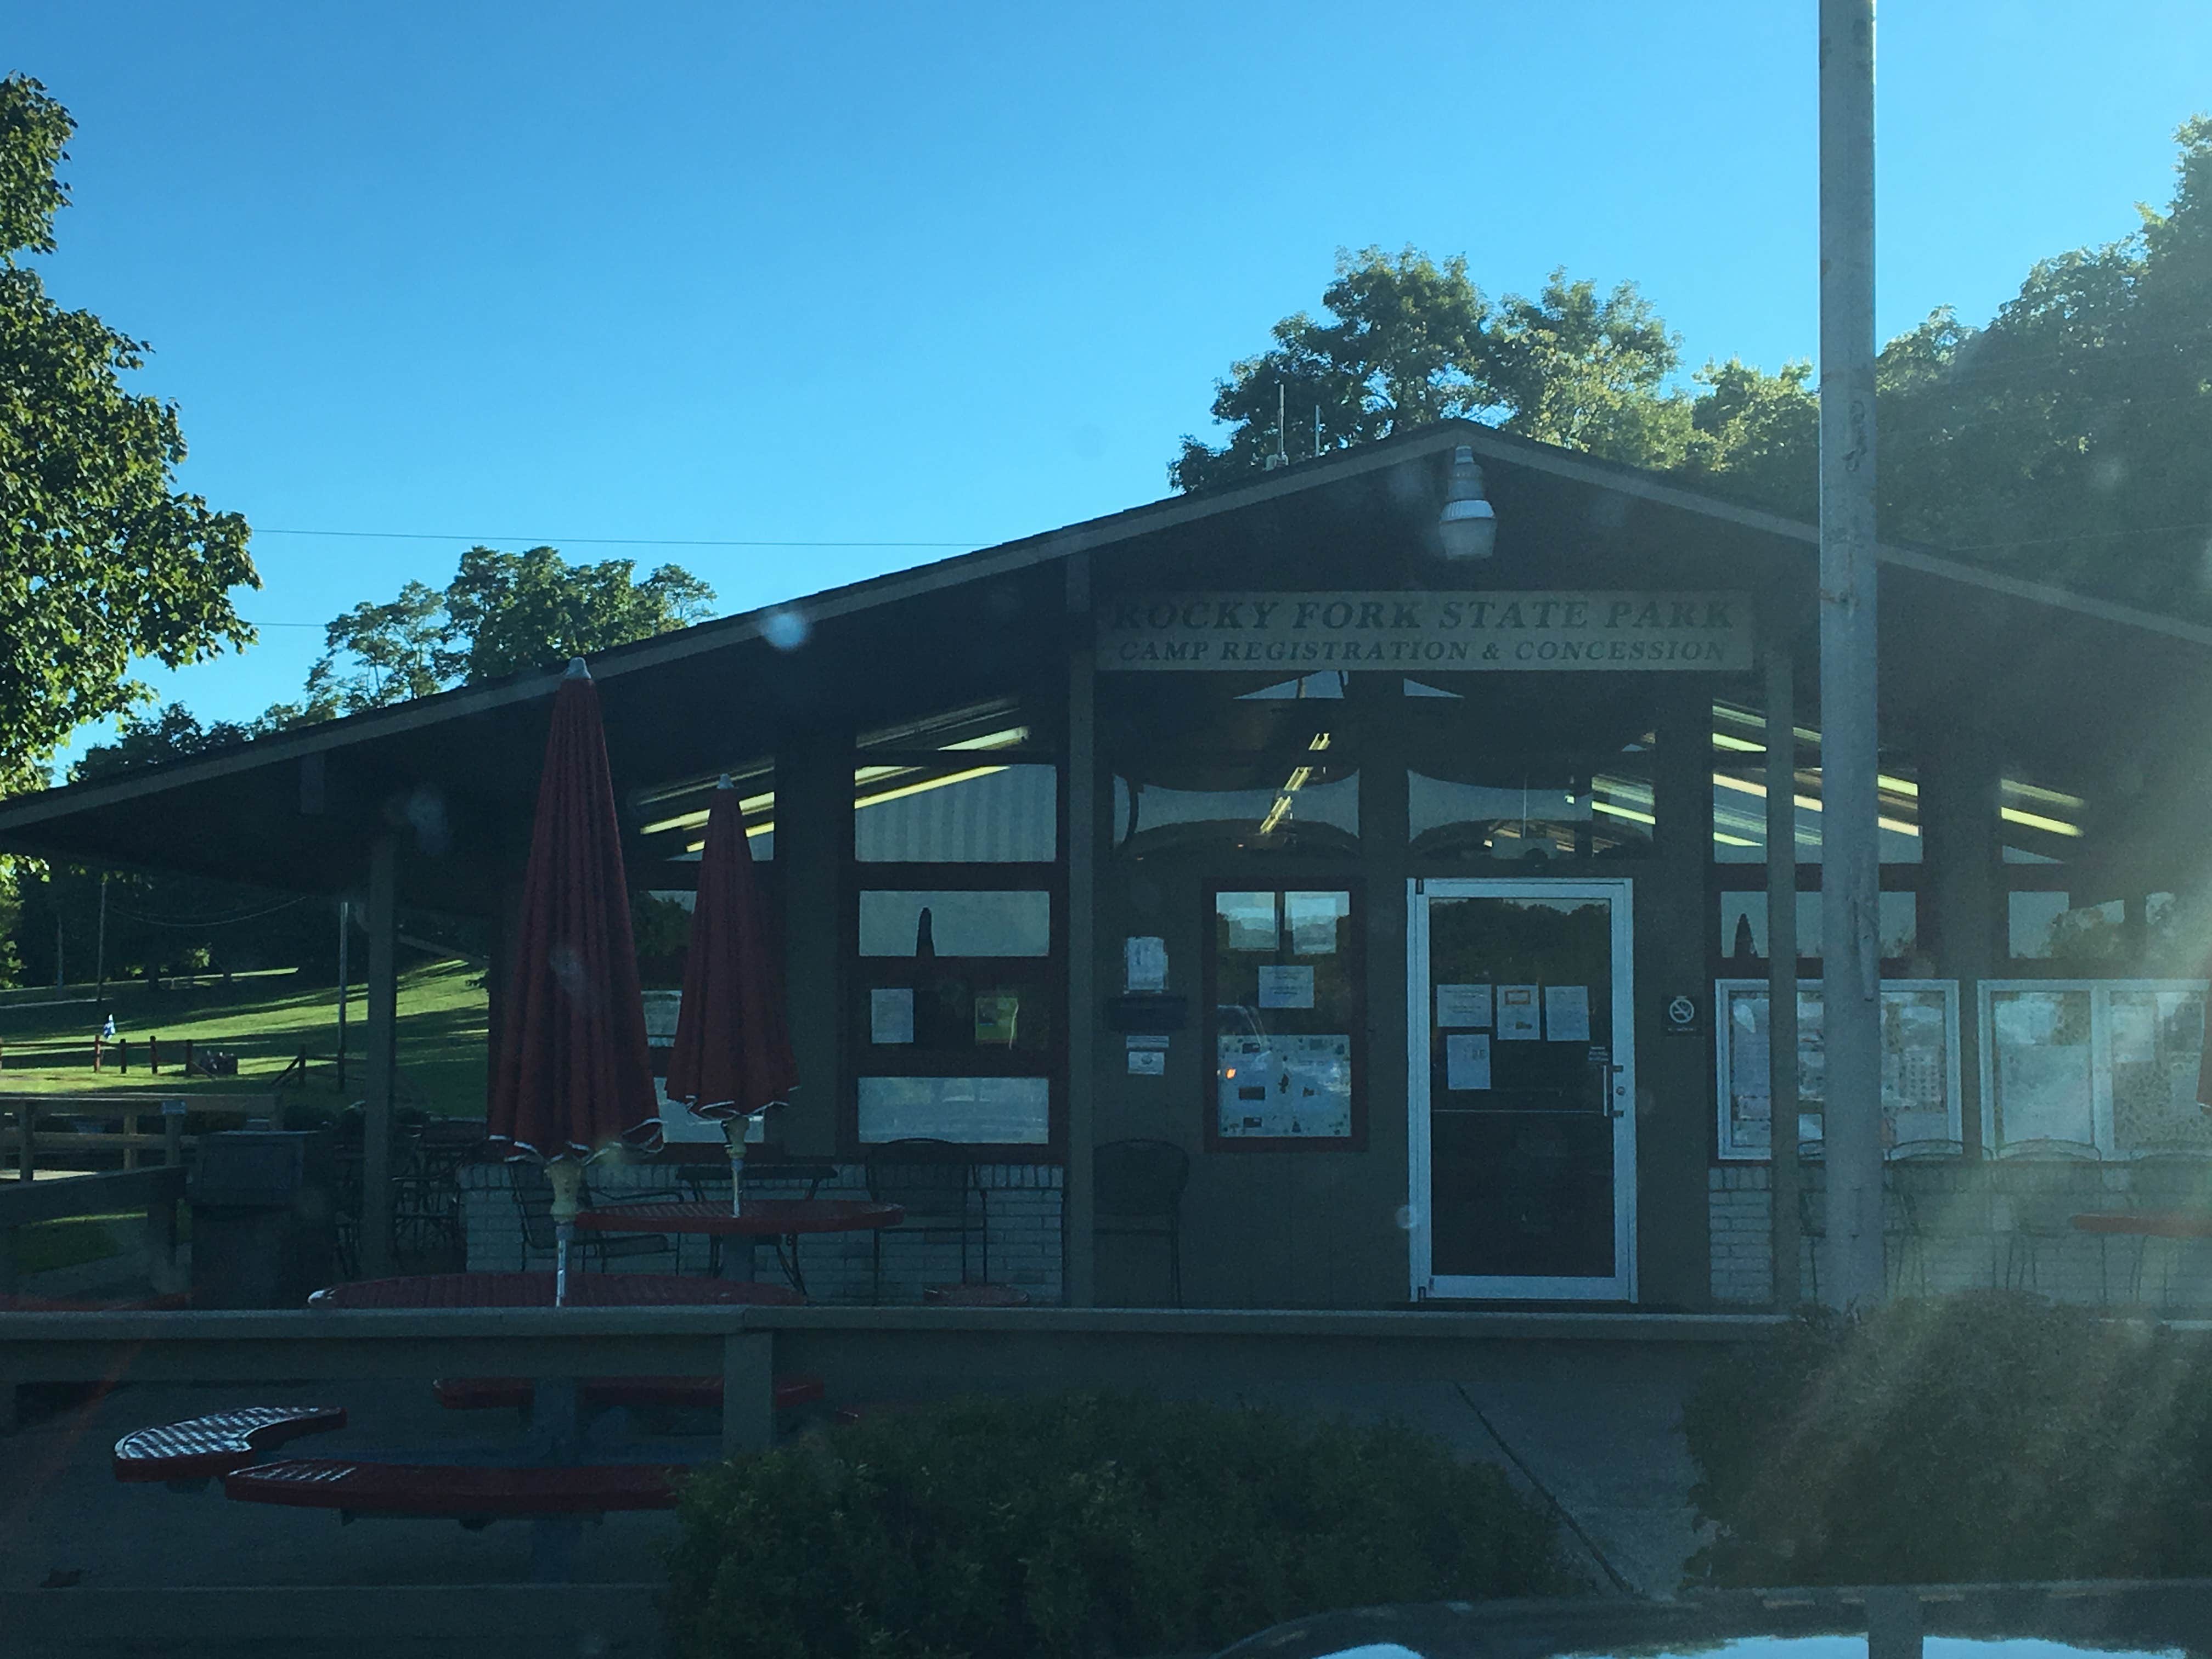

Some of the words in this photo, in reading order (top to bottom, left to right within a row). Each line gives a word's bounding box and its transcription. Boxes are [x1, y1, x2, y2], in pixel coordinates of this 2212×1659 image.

[1114, 601, 1279, 629] ROCKY
[1293, 601, 1421, 629] FORK
[1438, 601, 1589, 629] STATE
[1605, 601, 1734, 628] PARK
[1119, 642, 1209, 661] CAMP
[1220, 641, 1468, 661] REGISTRATION
[1482, 642, 1500, 660] &
[1515, 640, 1725, 660] CONCESSION
